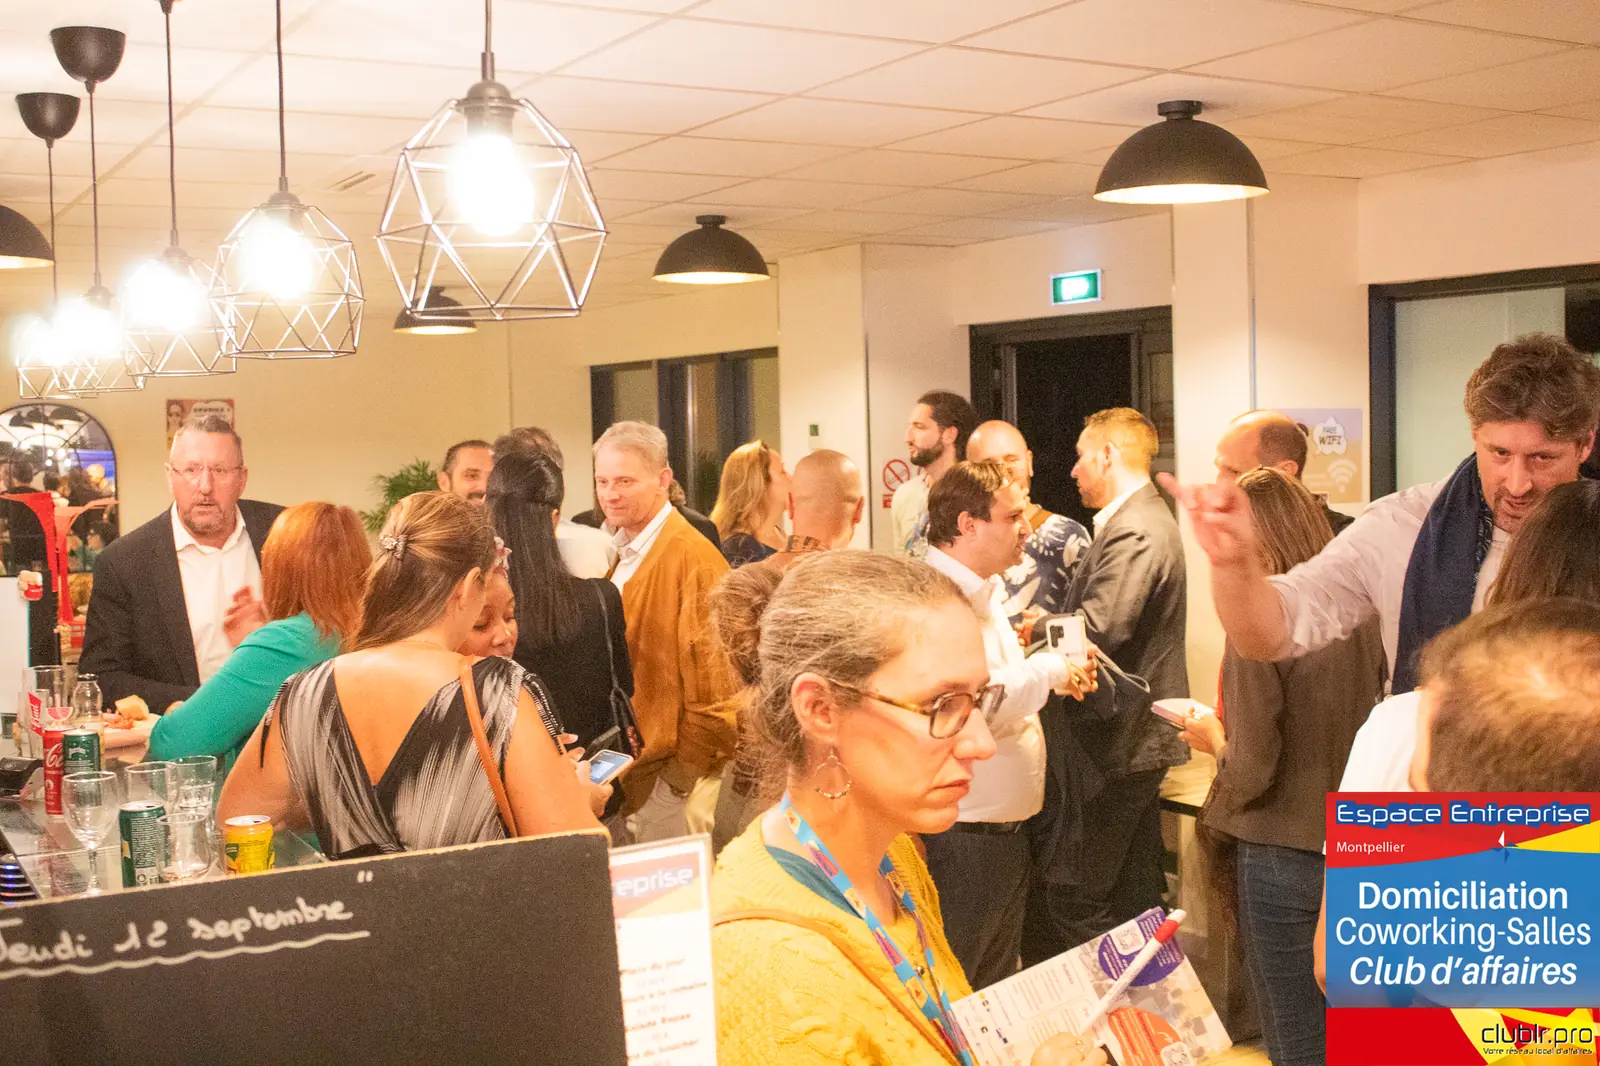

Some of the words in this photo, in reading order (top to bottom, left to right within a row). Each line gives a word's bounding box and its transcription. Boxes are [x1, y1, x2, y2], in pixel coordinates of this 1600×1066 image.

[1319, 435, 1342, 446] WIFI
[114, 920, 168, 952] 12
[187, 897, 354, 942] septembre
